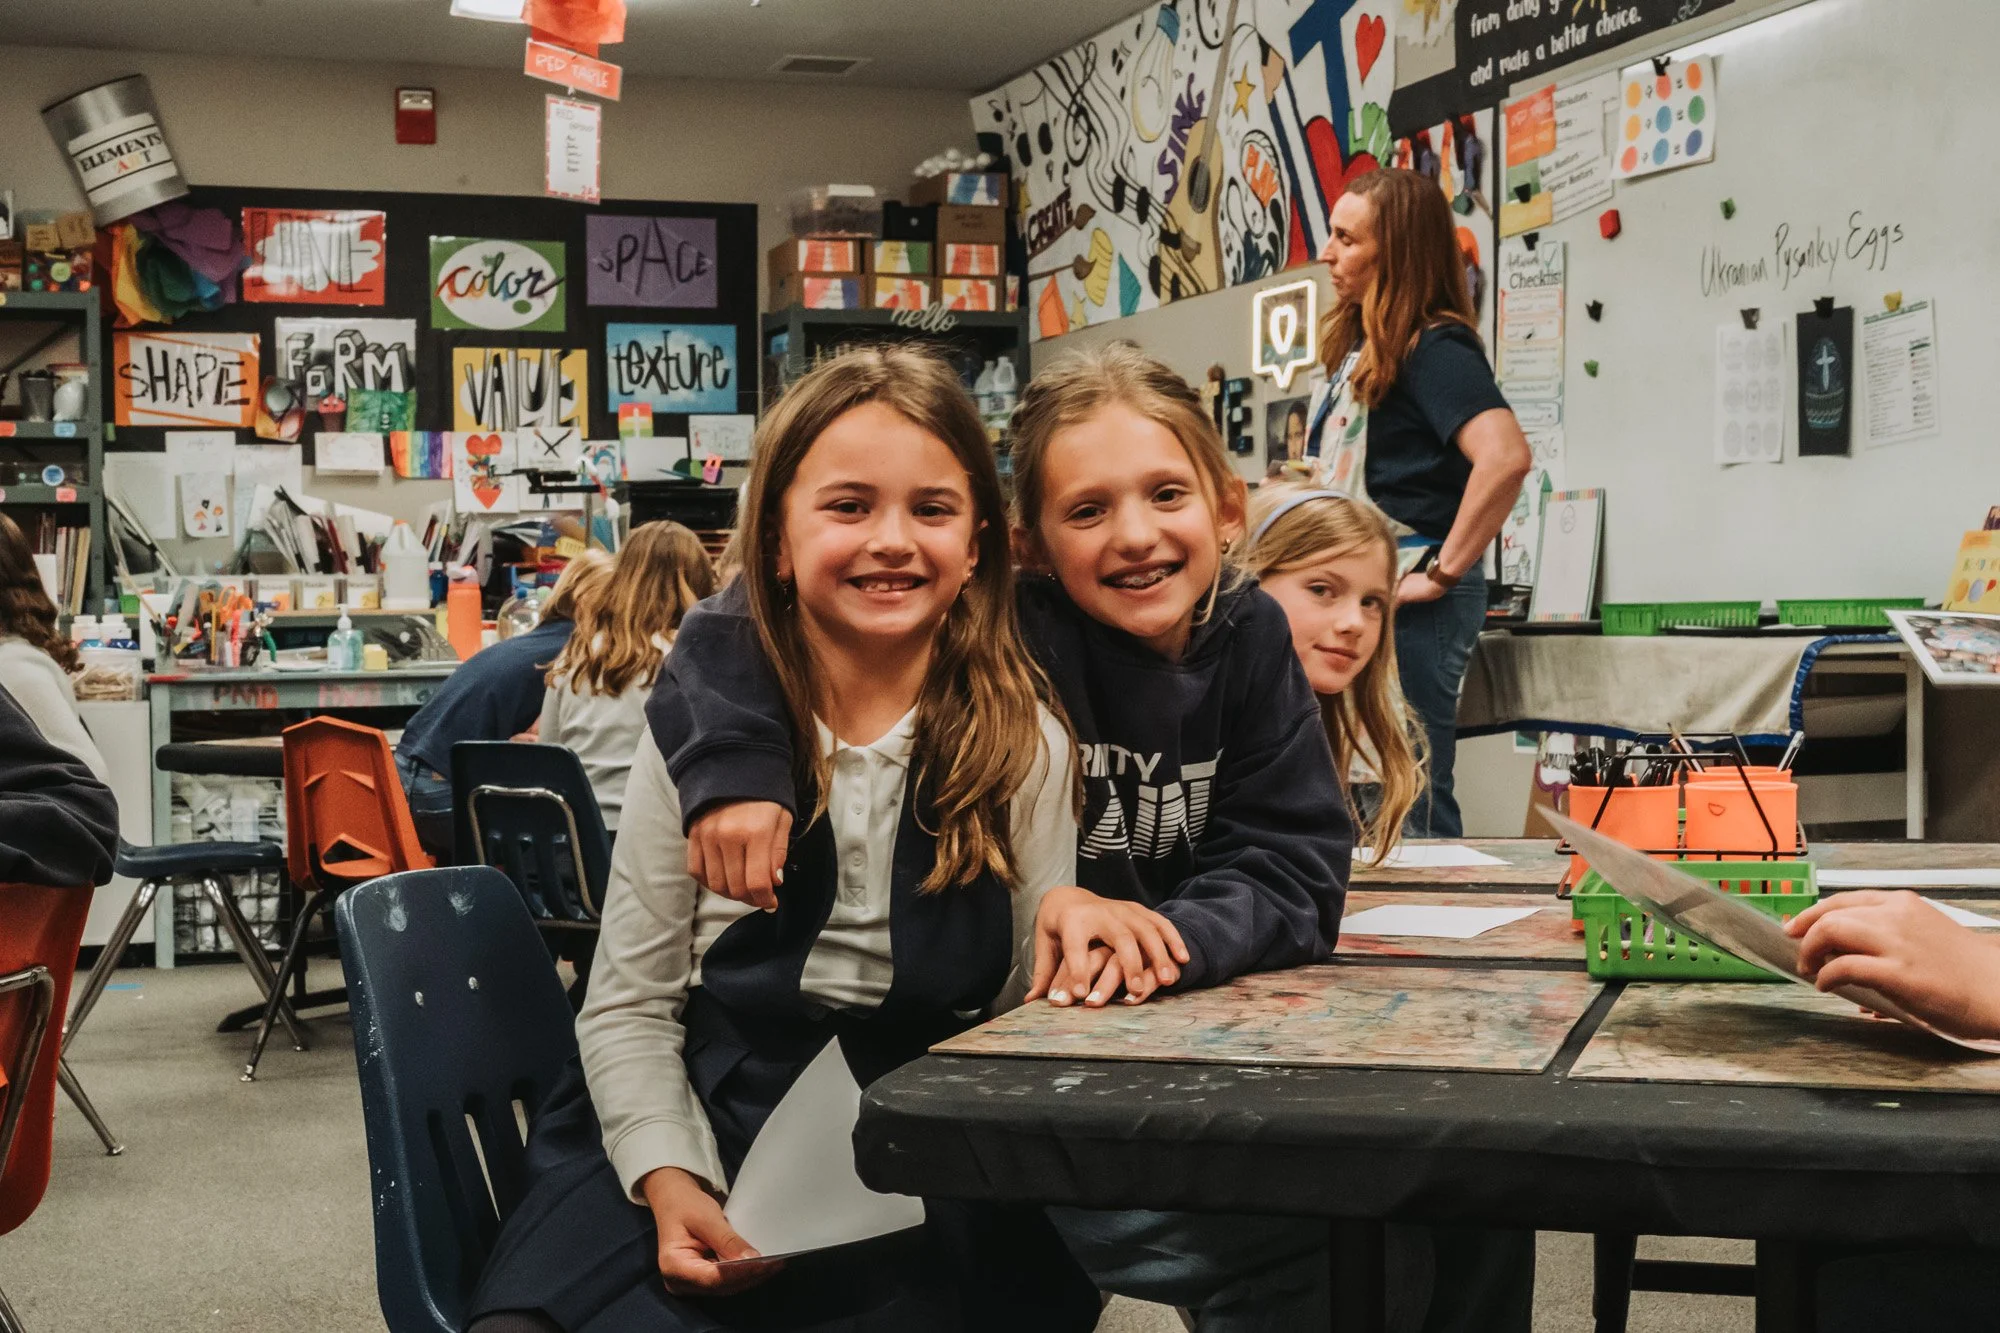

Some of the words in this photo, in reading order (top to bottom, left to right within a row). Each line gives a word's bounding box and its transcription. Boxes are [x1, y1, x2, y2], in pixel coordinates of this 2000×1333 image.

[1470, 13, 1500, 38] from
[1506, 0, 1540, 21] doing
[1470, 57, 1493, 87] and
[1500, 49, 1530, 76] make
[1536, 43, 1546, 60] a
[1550, 23, 1589, 55] better
[1595, 6, 1642, 37] choice.
[79, 131, 163, 173] ELEMENTS
[115, 150, 152, 174] ART
[251, 211, 374, 293] LINE
[1028, 186, 1073, 252] CREATE
[1775, 222, 1840, 291] Pysanky
[1845, 210, 1904, 271] Eggs
[434, 251, 565, 299] color
[598, 217, 709, 298] SPACE
[890, 302, 959, 332] hello
[118, 346, 250, 408] SHAPE
[286, 329, 409, 403] FORM
[464, 349, 581, 432] VALUE
[613, 330, 732, 396] texture
